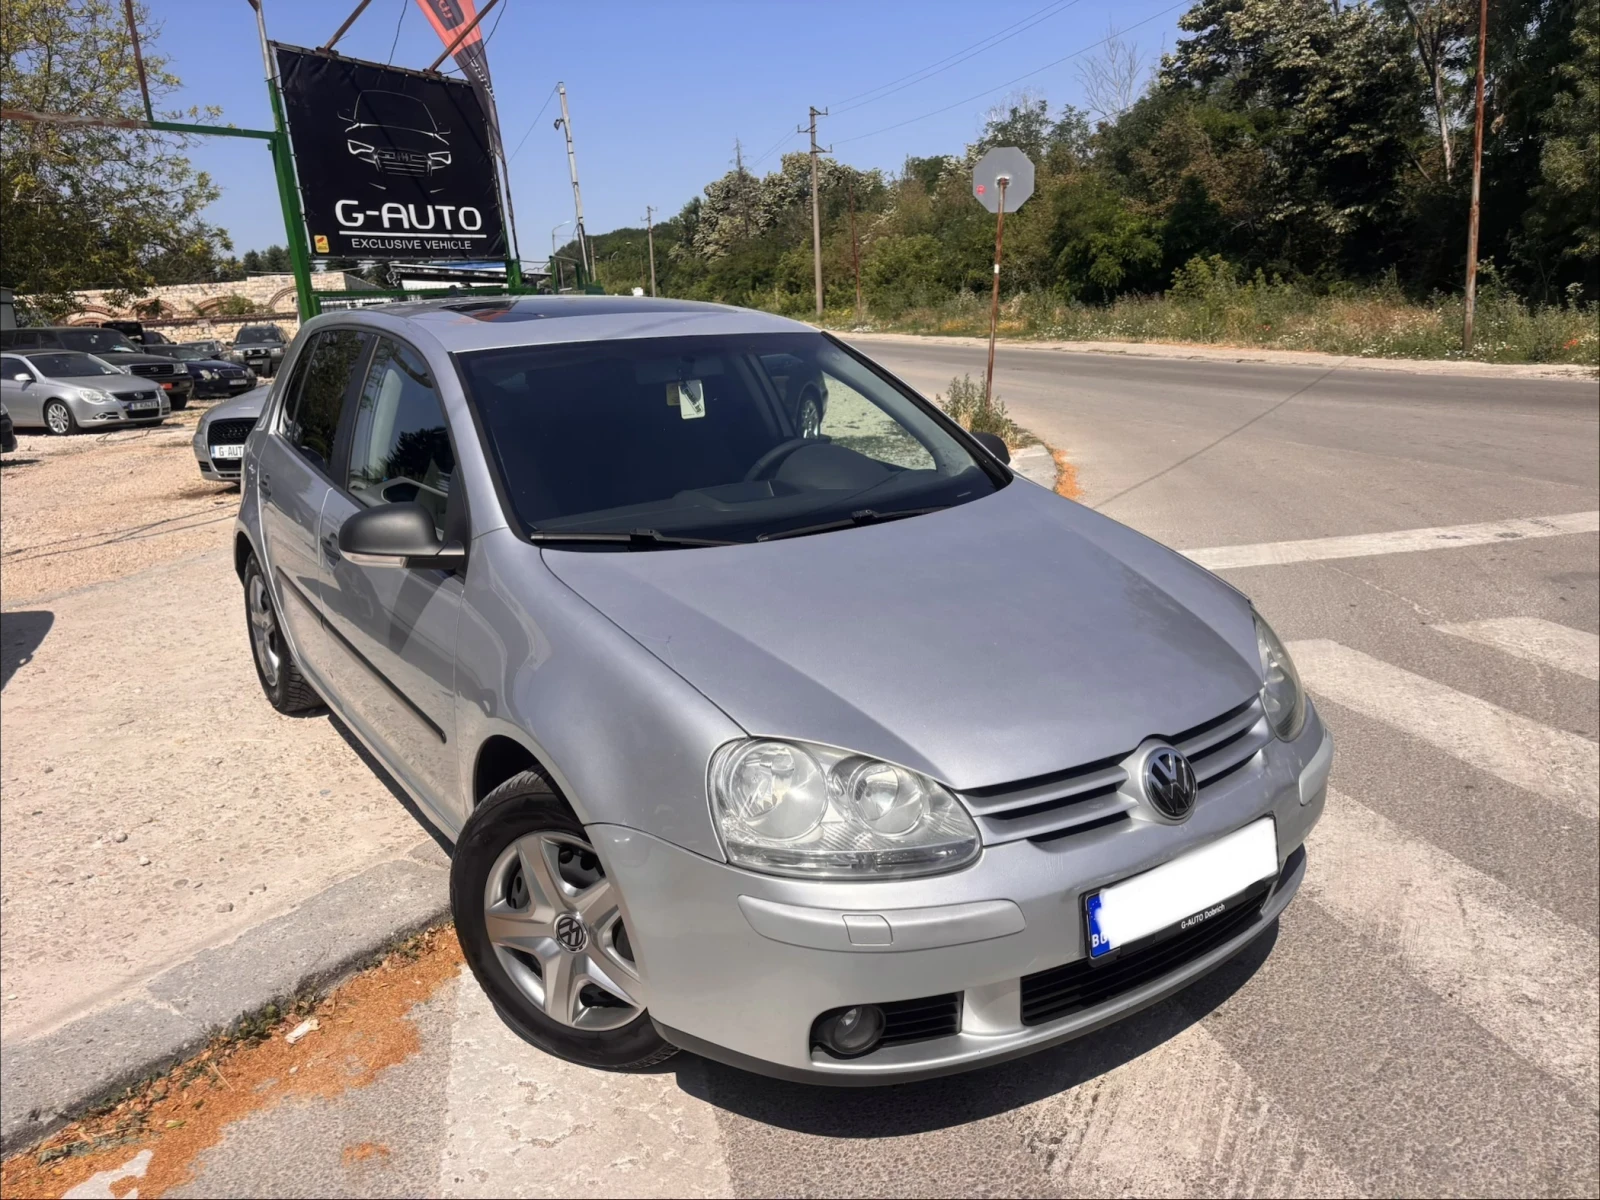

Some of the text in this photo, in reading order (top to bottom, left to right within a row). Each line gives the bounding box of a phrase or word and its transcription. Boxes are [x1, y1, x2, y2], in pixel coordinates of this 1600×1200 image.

[335, 199, 482, 231] G-AUTO
[351, 238, 472, 249] EXCLUSIVE VEHICLE
[1181, 903, 1226, 929] G-AUTO Dobrich
